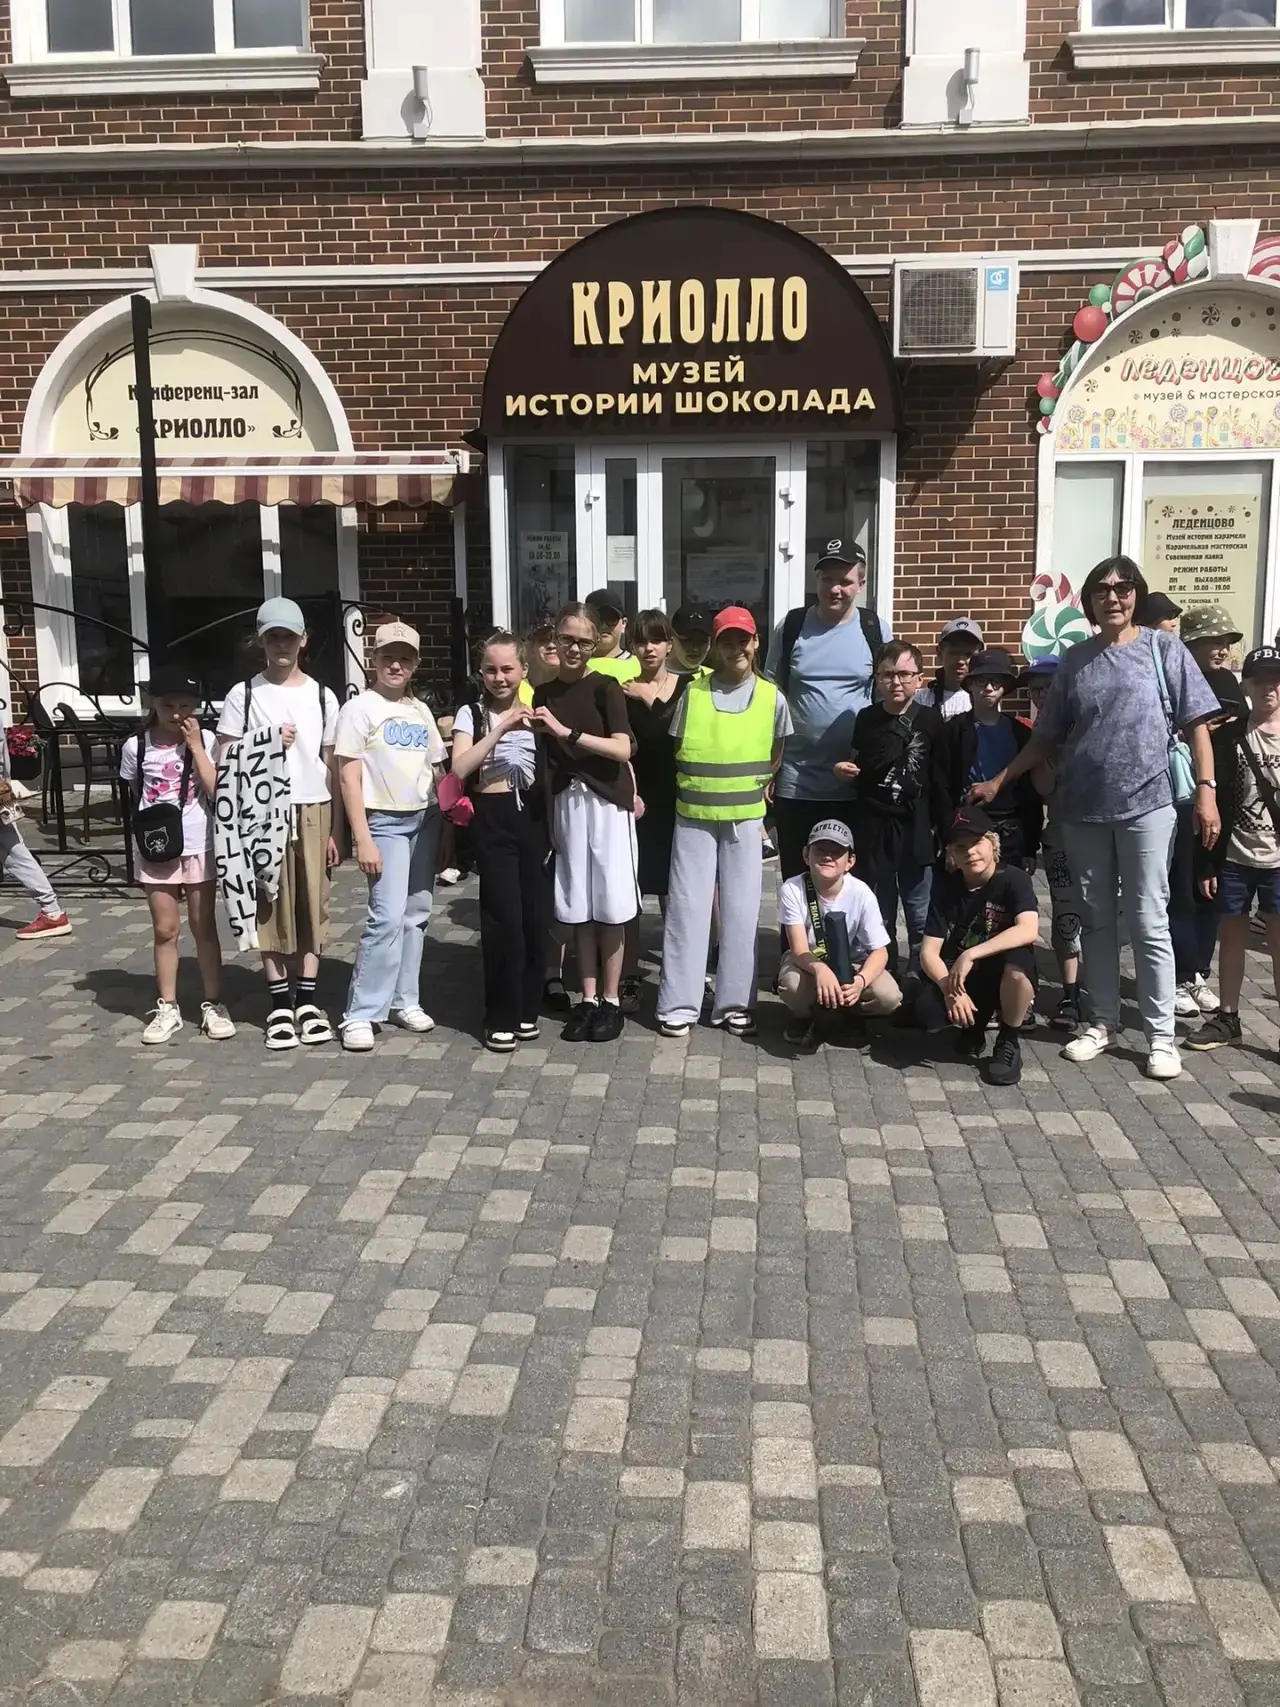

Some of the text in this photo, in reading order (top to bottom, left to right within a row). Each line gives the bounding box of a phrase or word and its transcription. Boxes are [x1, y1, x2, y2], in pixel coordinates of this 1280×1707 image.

[572, 275, 808, 345] КРИОЛЛО
[633, 355, 745, 385] МУЗЕЙ
[127, 384, 259, 401] Кнференц-зал
[505, 387, 876, 416] ИСТОРИИ ШОКОЛАДА
[1144, 390, 1182, 402] музей
[1187, 389, 1195, 400] &
[1172, 518, 1235, 529] ЛЕДЕНЦОВО
